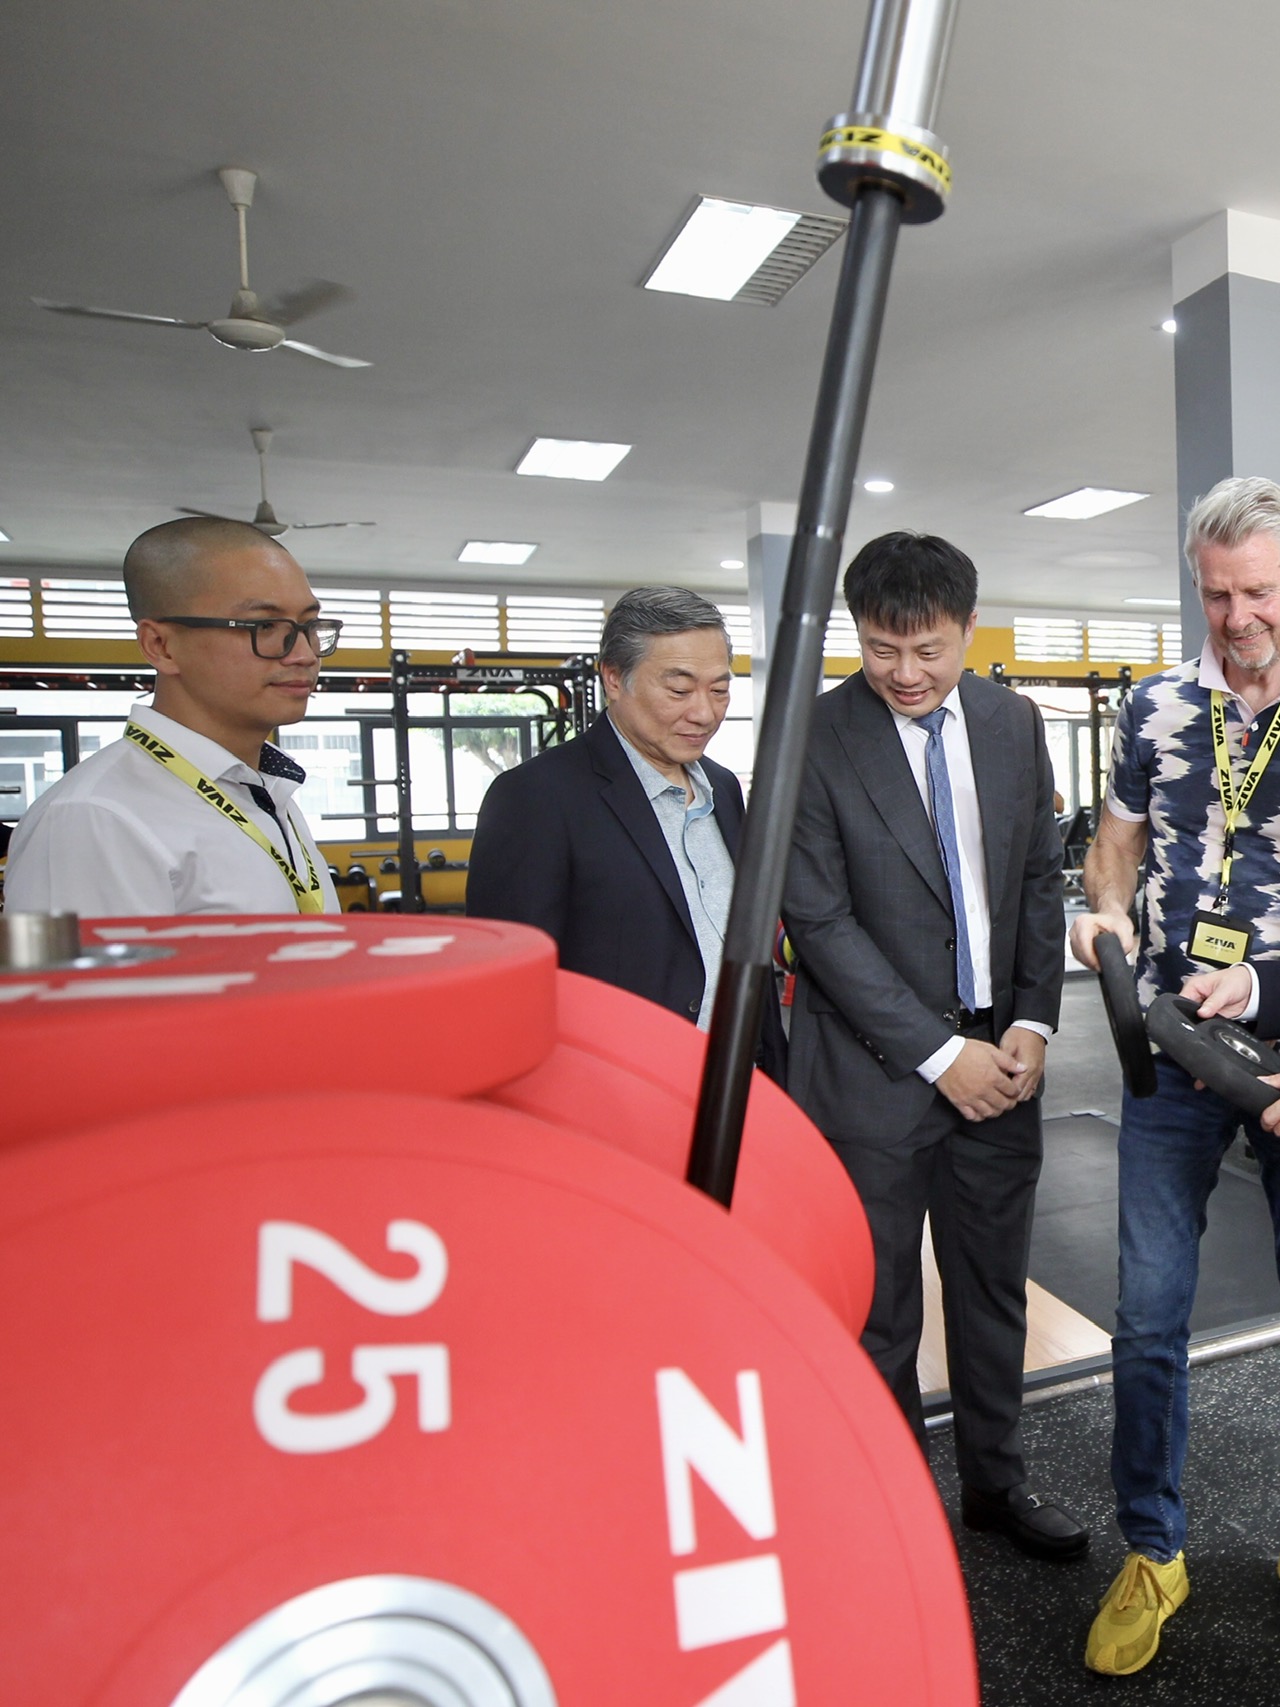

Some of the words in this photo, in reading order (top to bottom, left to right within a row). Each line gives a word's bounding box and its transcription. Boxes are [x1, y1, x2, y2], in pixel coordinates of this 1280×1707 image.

[466, 668, 513, 678] ZIVA
[125, 725, 175, 763] ZIVA
[1213, 704, 1225, 746] ZIVA
[197, 778, 248, 826] ZIVA
[1220, 769, 1233, 811] ZIVA
[1236, 772, 1260, 811] ZIVA
[270, 846, 306, 897] ZIVA
[1205, 936, 1235, 949] ZIVA
[253, 1219, 451, 1455] 25
